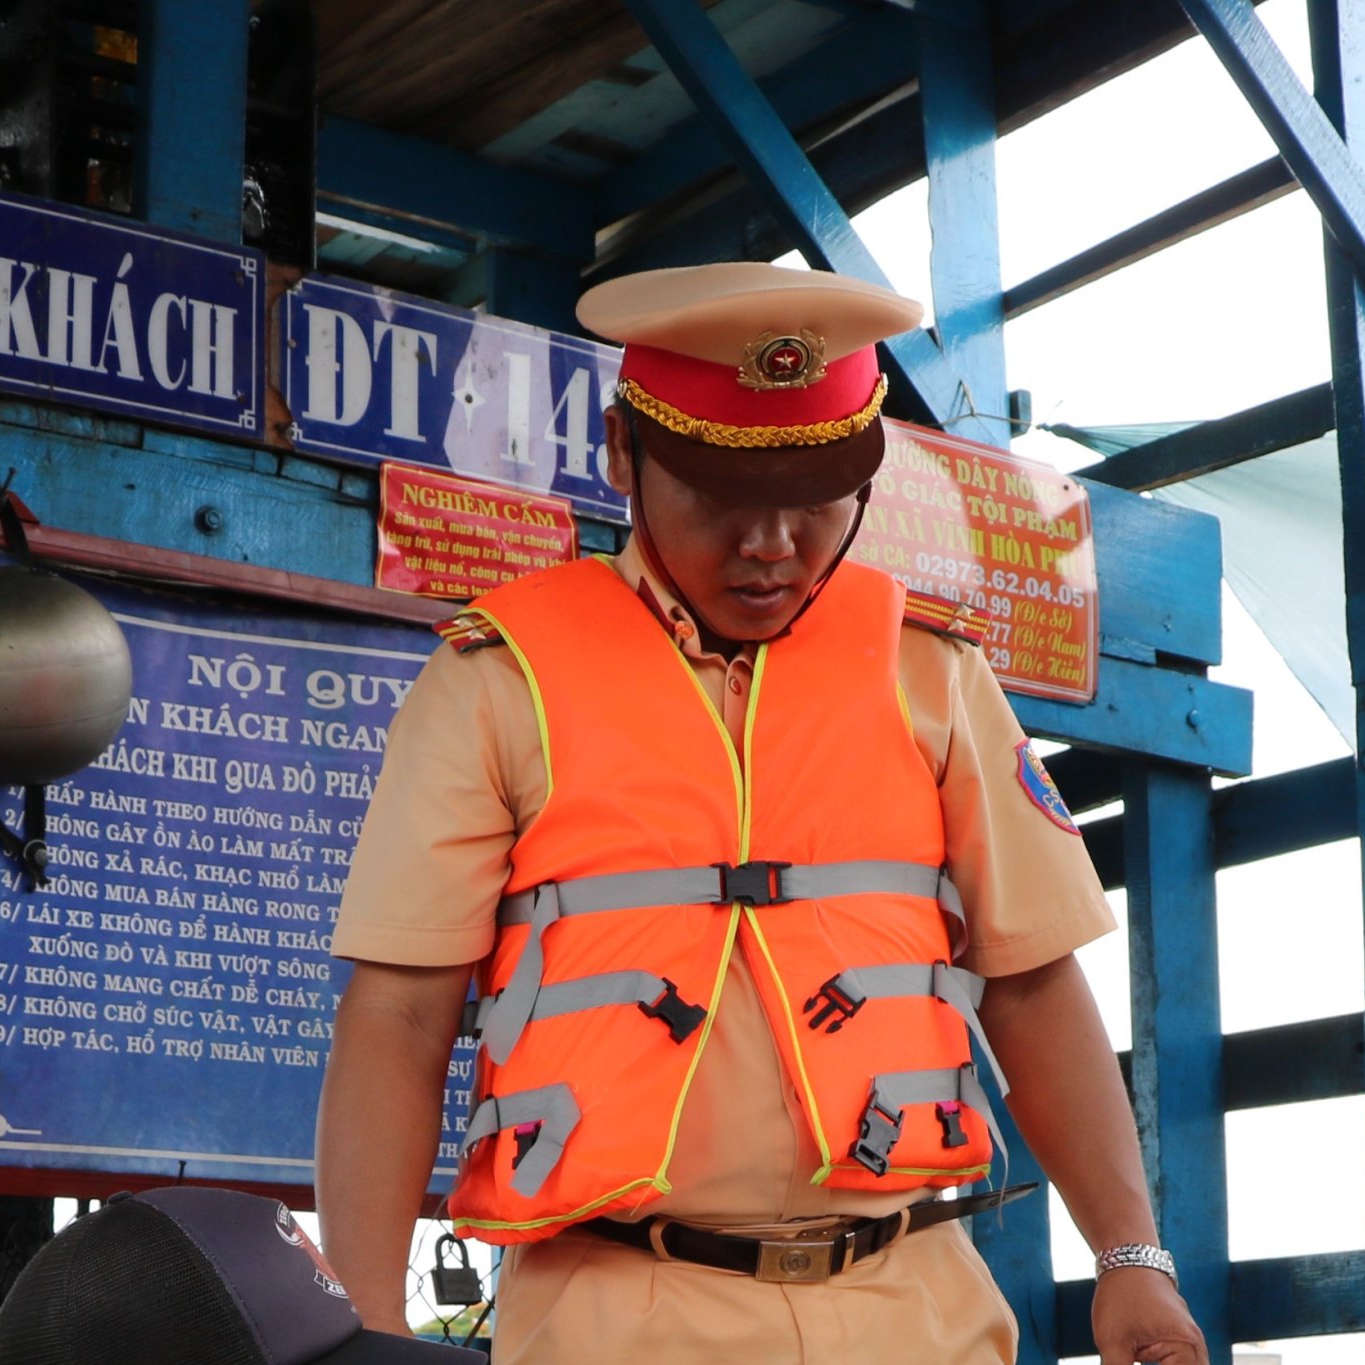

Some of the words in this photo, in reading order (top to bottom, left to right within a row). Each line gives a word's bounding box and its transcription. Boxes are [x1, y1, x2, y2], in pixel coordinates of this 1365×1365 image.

[301, 303, 437, 443] ĐT
[955, 456, 1001, 491] DÂY
[1004, 468, 1059, 508] NÓNG
[402, 483, 499, 519] NGHIÊM
[503, 501, 557, 529] CẤM
[901, 475, 962, 511] GIÁC
[967, 494, 1007, 524] TỘI
[1012, 506, 1078, 541] PHẠM
[449, 521, 473, 535] mua
[502, 529, 521, 546] vận
[452, 542, 480, 558] dụng
[504, 550, 531, 566] phép
[895, 508, 926, 541] XÃ
[932, 515, 984, 556] VĨNH
[991, 530, 1035, 569] HÒA
[447, 582, 469, 596] các
[470, 565, 498, 582] công
[916, 551, 1084, 608] 02973.62.04.05
[188, 653, 286, 698] NỘI
[306, 670, 415, 709] QUY
[161, 703, 288, 743] KHÁCH
[172, 748, 217, 784] KHI
[225, 760, 275, 794] QUA
[282, 762, 316, 794] ĐÒ
[90, 791, 147, 815] HÀNH
[153, 800, 206, 822] THEO
[213, 806, 283, 830] HƯỚNG
[290, 809, 332, 834] DẪN
[105, 822, 147, 844] GÂY
[153, 821, 181, 848] ỒN
[187, 830, 214, 852] ÀO
[221, 835, 264, 857] LÀM
[270, 838, 314, 862] MẤT
[105, 850, 133, 873] XẢ
[140, 855, 187, 880] RÁC,
[195, 864, 252, 887] KHẠC
[258, 865, 299, 890] NHỔ
[105, 883, 152, 905] MUA
[155, 887, 196, 909] BÁN
[202, 892, 259, 916] HÀNG
[266, 900, 320, 922] RONG
[27, 903, 60, 925] LÁI
[65, 909, 94, 928] XE
[100, 912, 172, 937] KHÔNG
[179, 914, 207, 939] ĐỂ
[213, 922, 270, 946] HÀNH
[28, 932, 98, 960] XUỐNG
[105, 941, 133, 962] ĐÒ
[140, 944, 168, 966] VÀ
[175, 950, 212, 970] KHI
[218, 954, 271, 977] VƯỢT
[277, 957, 331, 981] SÔNG
[25, 965, 97, 989] KHÔNG
[104, 974, 163, 995] MANG
[170, 976, 225, 1000] CHẤT
[231, 979, 258, 1003] DỄ
[265, 987, 326, 1011] CHÁY,
[24, 996, 97, 1019] KHÔNG
[104, 1001, 147, 1023] CHỞ
[153, 1005, 193, 1027] SÚC
[199, 1009, 245, 1034] VẬT,
[251, 1014, 291, 1038] VẬT
[23, 1027, 65, 1050] HỢP
[72, 1029, 119, 1054] TÁC,
[162, 1039, 203, 1061] TRỢ
[210, 1041, 265, 1063] NHÂN
[271, 1046, 318, 1067] VIÊN
